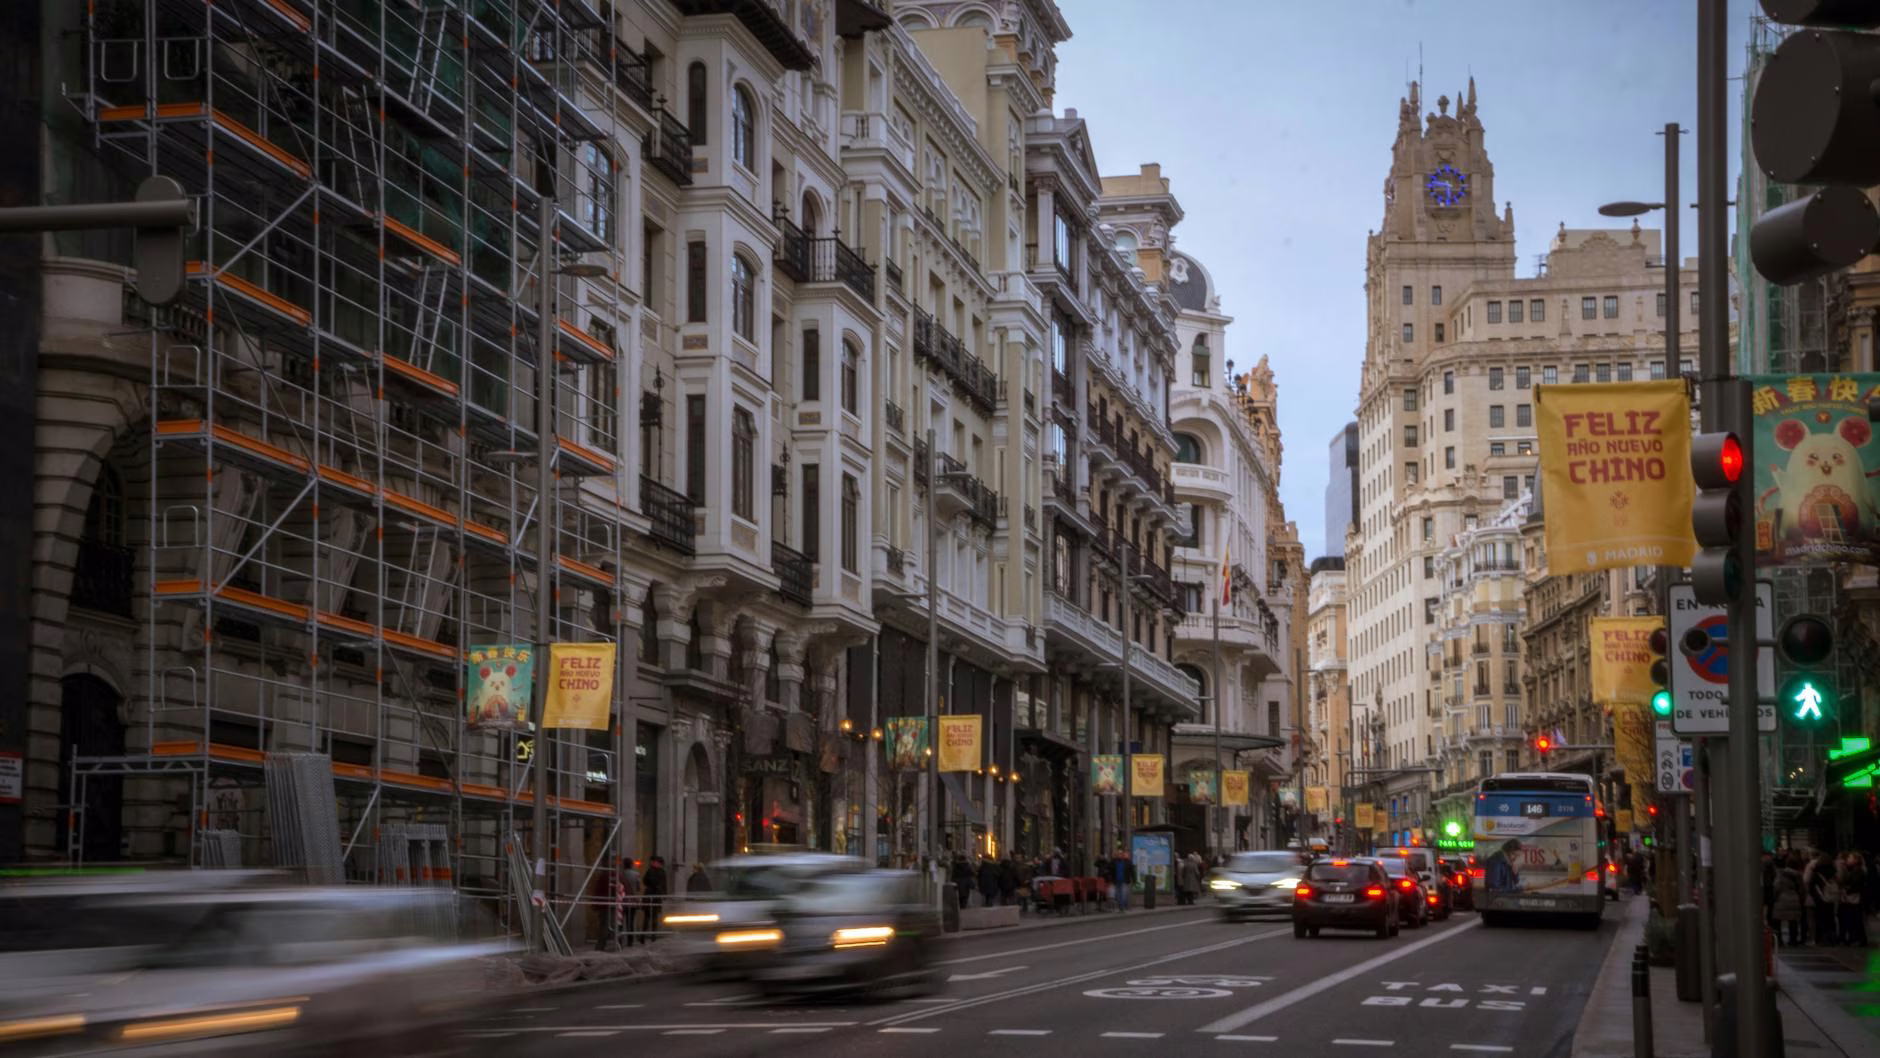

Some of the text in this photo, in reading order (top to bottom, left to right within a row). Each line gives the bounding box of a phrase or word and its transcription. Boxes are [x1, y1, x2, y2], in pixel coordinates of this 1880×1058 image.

[1752, 375, 1880, 416] 新春快
[1563, 410, 1663, 438] FELIZ
[1567, 438, 1663, 456] AÑO NUEVO
[1568, 457, 1666, 484] CHINO
[1605, 546, 1664, 561] MADRID
[1676, 598, 1698, 610] EN
[560, 657, 601, 669] FELIZ
[559, 679, 600, 690] CHINO
[1688, 690, 1723, 701] TODO
[1676, 709, 1692, 719] DE
[1526, 803, 1543, 814] 146
[1379, 981, 1547, 995] TAXI
[1360, 996, 1526, 1011] BUS
